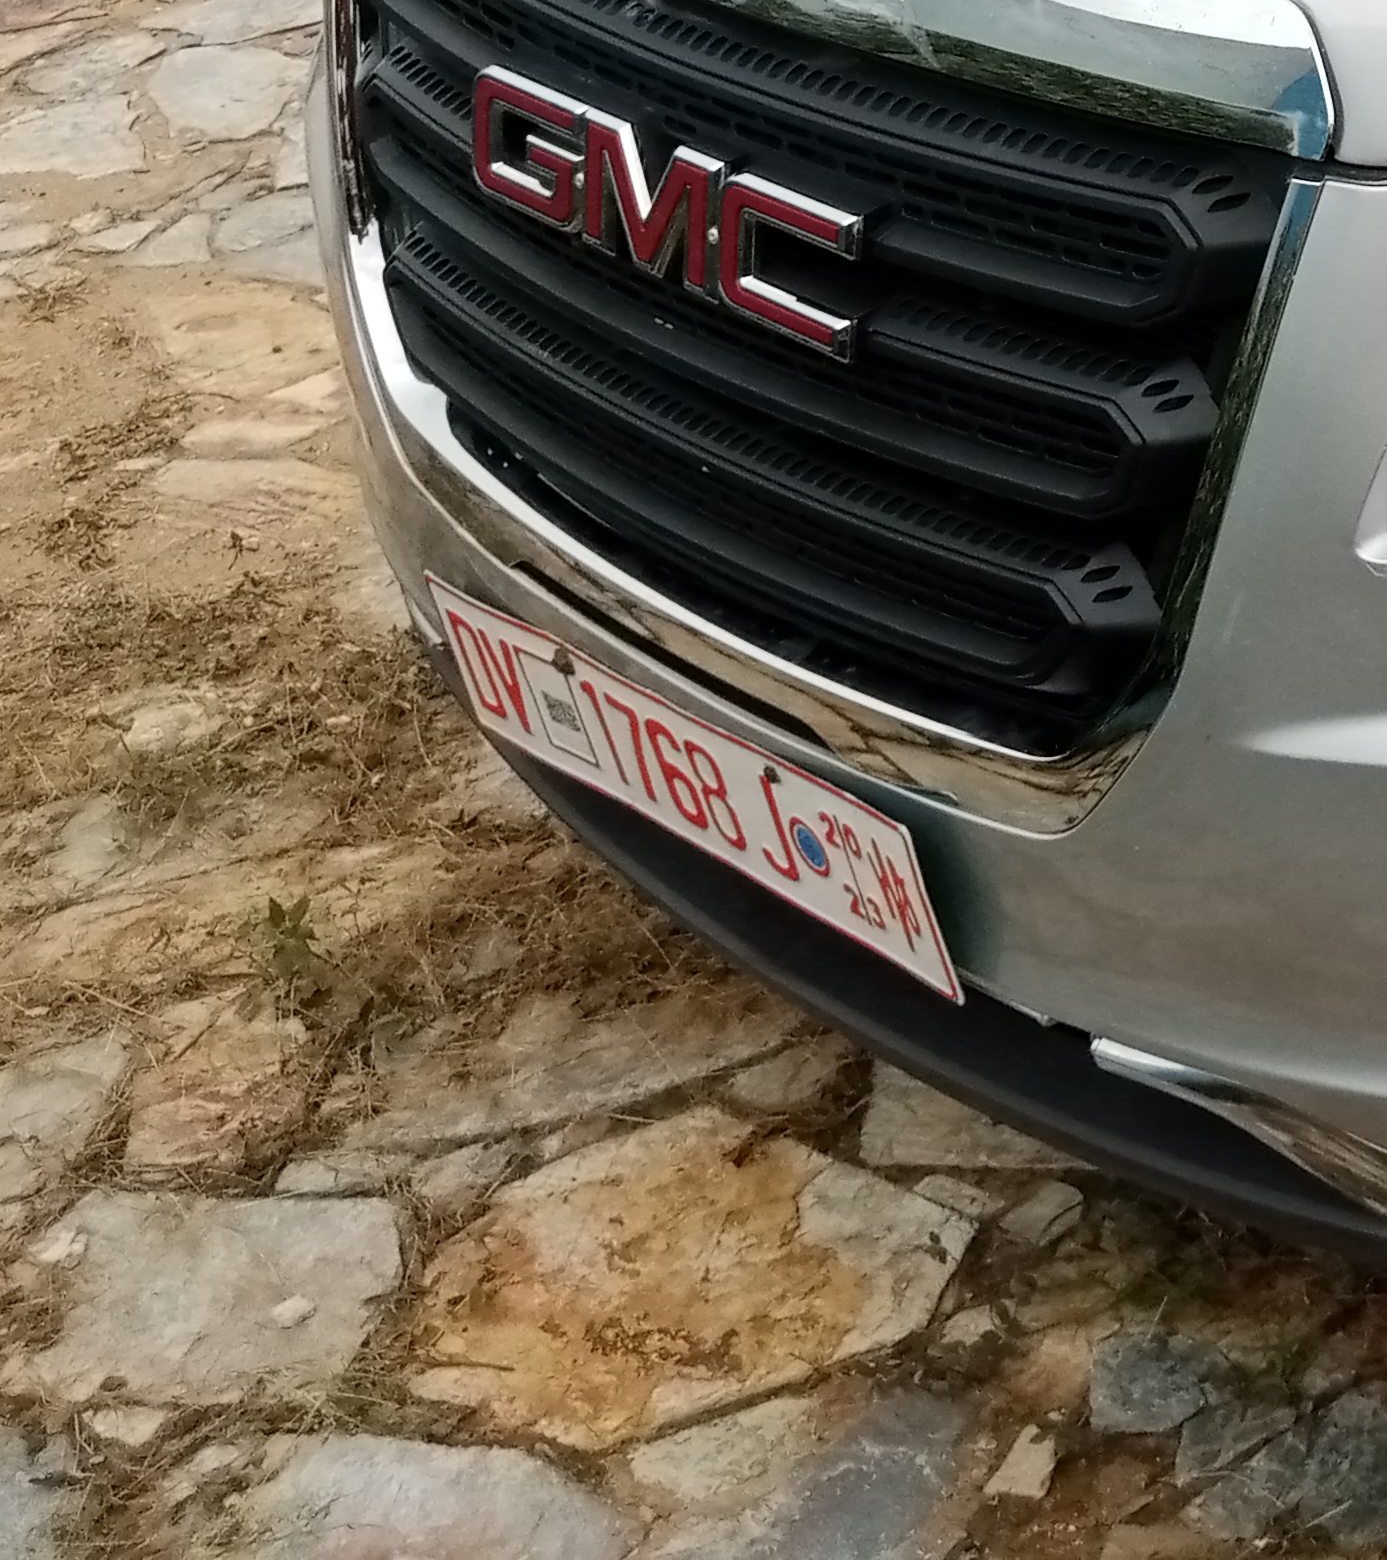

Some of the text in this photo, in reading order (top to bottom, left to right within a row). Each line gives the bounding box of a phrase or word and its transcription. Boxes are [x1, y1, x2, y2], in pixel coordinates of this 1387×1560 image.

[474, 64, 864, 364] GMC
[447, 609, 799, 881] DV 1768 J
